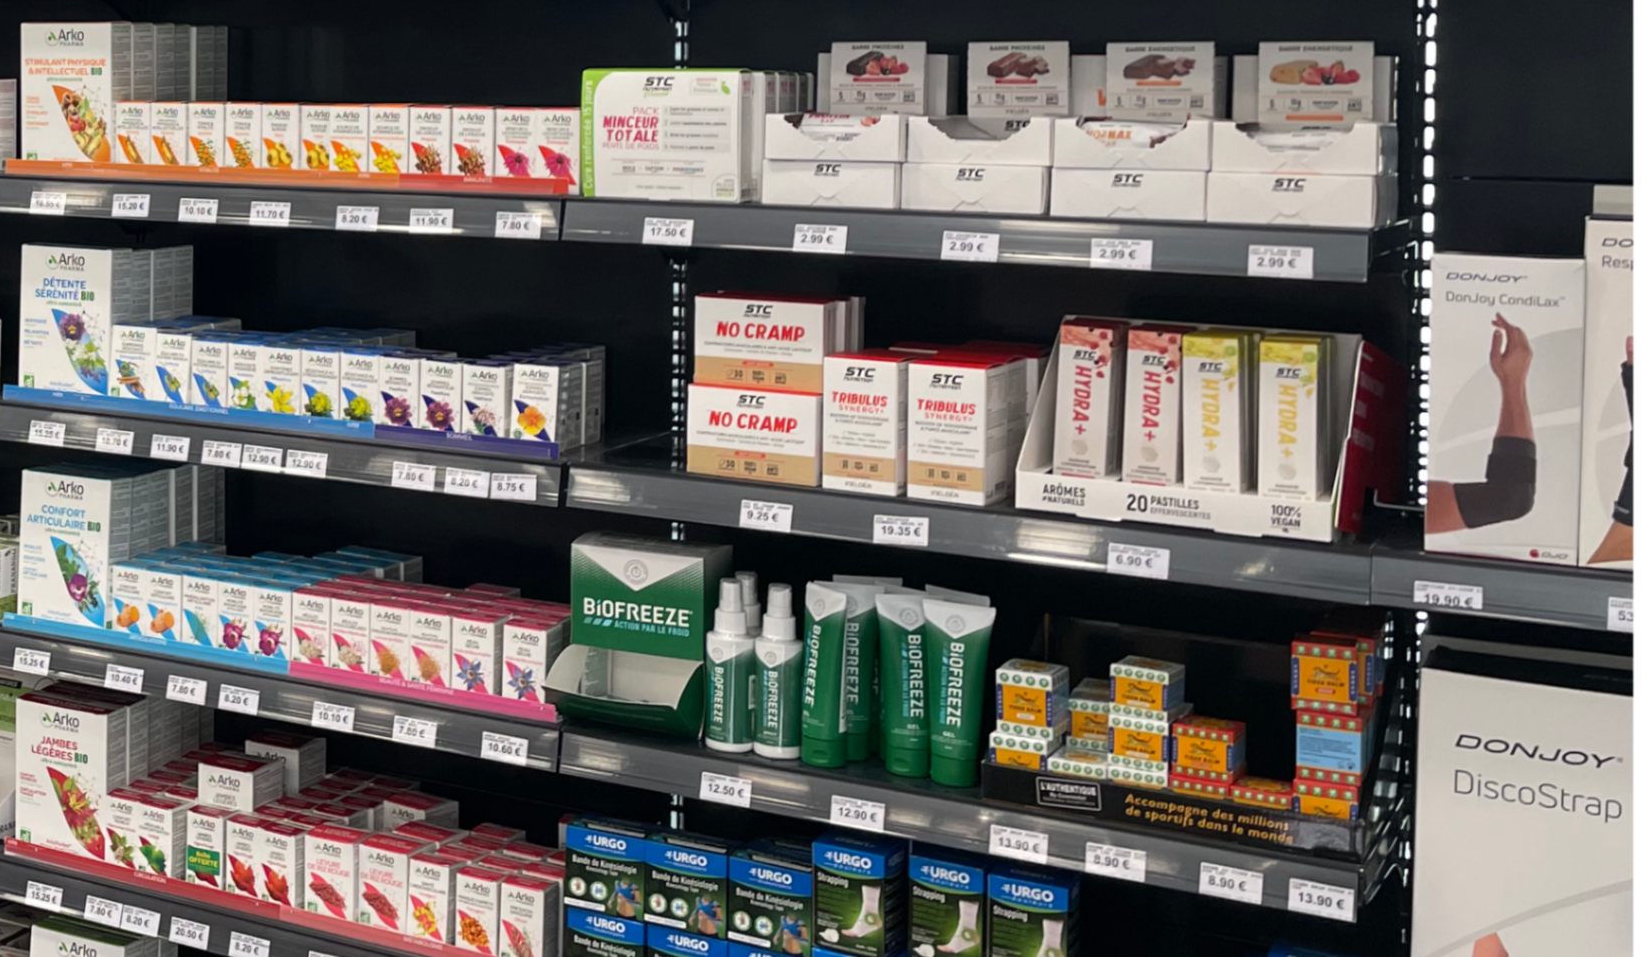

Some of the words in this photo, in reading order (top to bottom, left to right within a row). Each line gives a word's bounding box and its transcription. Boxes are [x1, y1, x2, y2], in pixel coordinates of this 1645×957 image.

[58, 30, 84, 41] Arko
[644, 76, 675, 86] STC
[603, 116, 659, 128] MINCEUR
[606, 130, 658, 142] TOTALE
[1113, 173, 1143, 185] STC
[800, 234, 824, 244] 2.99
[825, 234, 834, 245] €
[43, 277, 86, 290] DÉTENTE
[1446, 272, 1524, 283] DONJOY
[35, 288, 80, 300] SÉRÉNITÉ
[81, 290, 94, 302] BIO
[1445, 291, 1495, 307] DonJoy
[1499, 293, 1560, 307] CondiLax
[716, 321, 740, 338] NO
[744, 324, 805, 342] CRAMP
[846, 366, 876, 378] STC
[932, 374, 964, 385] STC
[832, 392, 888, 407] TRIBULUS
[917, 398, 976, 415] TRIBULUS
[709, 411, 732, 428] NO
[737, 414, 798, 434] CRAMP
[1042, 482, 1086, 499] ARÔMES
[1126, 493, 1148, 513] 20
[1150, 495, 1200, 510] PASTILLES
[41, 504, 85, 518] CONFORT
[747, 512, 769, 522] 9.25
[771, 513, 779, 523] €
[1271, 504, 1301, 517] 100%
[27, 514, 86, 530] ARTICULAIRE
[88, 522, 101, 532] BIO
[1271, 516, 1301, 527] VEGAN
[881, 525, 912, 536] 19.35
[913, 527, 921, 537] €
[1116, 556, 1141, 568] 6.90
[1144, 557, 1153, 569] €
[614, 620, 641, 631] ACTION
[642, 623, 657, 633] PAR
[658, 625, 667, 634] LE
[669, 627, 690, 638] FROID
[53, 712, 80, 728] Arko
[40, 735, 78, 751] JAMBES
[31, 744, 73, 762] LÉGÈRES
[74, 753, 88, 764] BIO
[1455, 734, 1616, 769] DONJOY
[707, 784, 735, 798] 12.50
[737, 788, 745, 799] €
[1454, 769, 1623, 824] DiscoStrap
[1124, 793, 1209, 819] Accompagne
[1212, 806, 1234, 820] des
[1238, 811, 1290, 831] millions
[1125, 805, 1140, 818] de
[1143, 810, 1195, 830] sportifs
[1198, 818, 1231, 833] dans
[1234, 823, 1243, 835] le
[1245, 824, 1294, 844] monde
[593, 834, 627, 852] URGO
[832, 850, 872, 870] URGO
[758, 867, 793, 885] URGO
[817, 870, 849, 890] Strapping
[1298, 891, 1332, 908] 13.90
[1334, 897, 1345, 911] €
